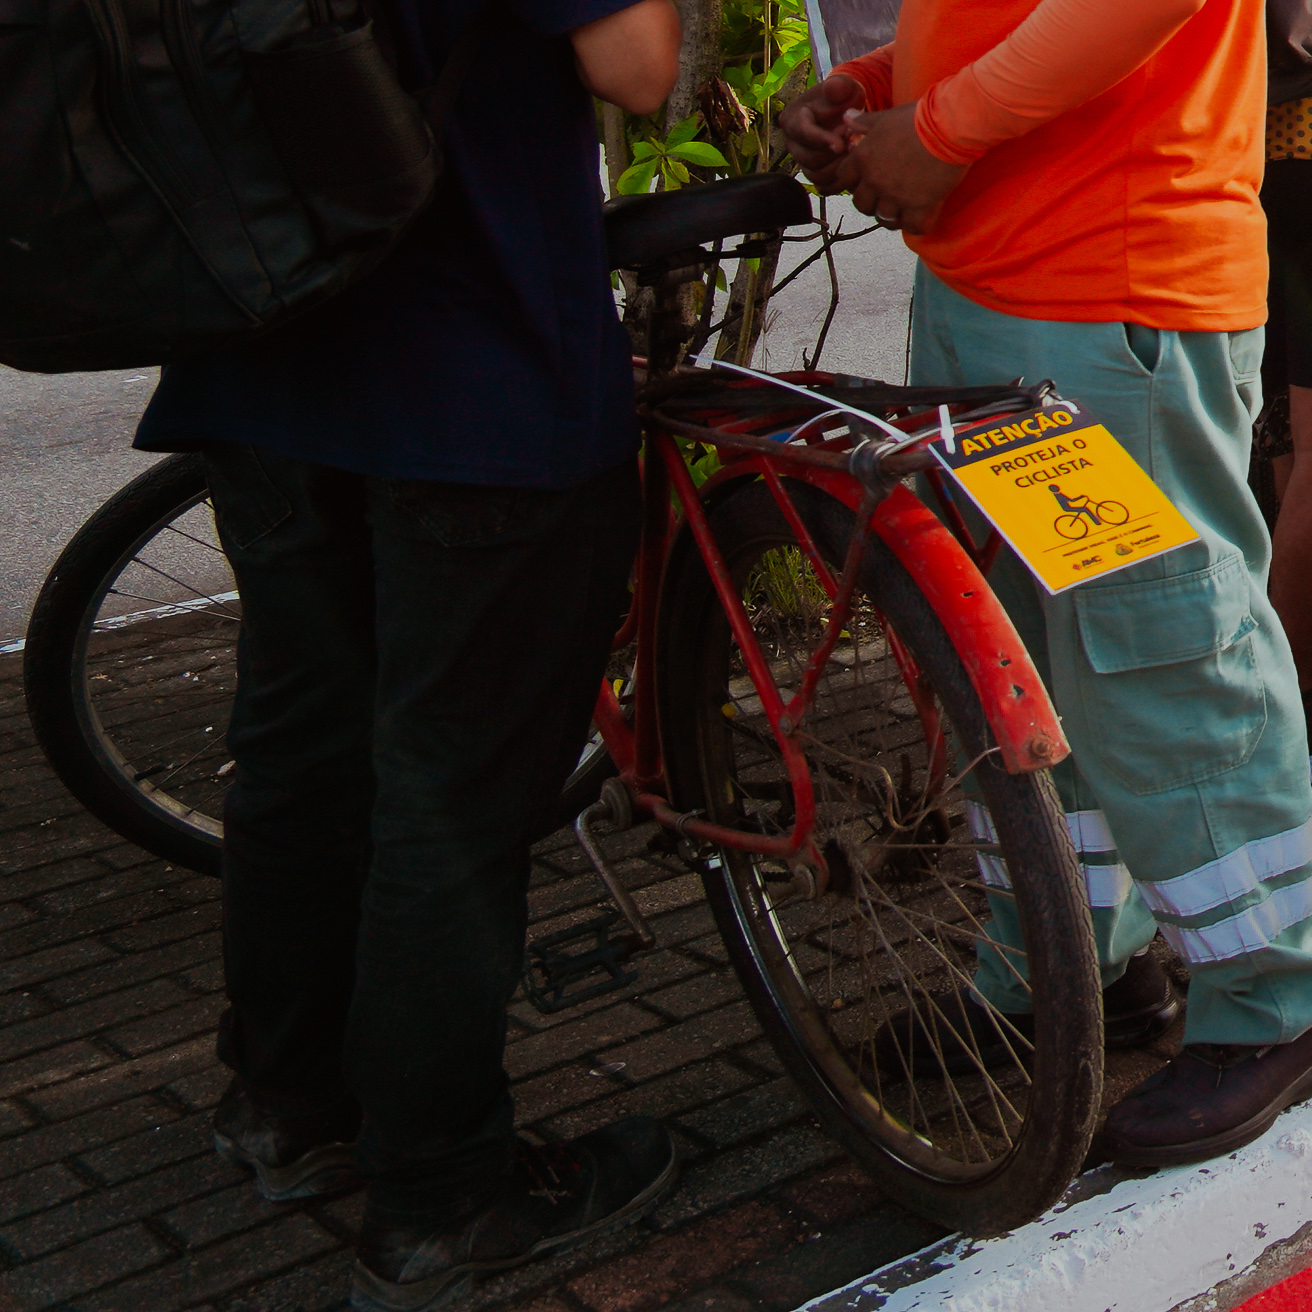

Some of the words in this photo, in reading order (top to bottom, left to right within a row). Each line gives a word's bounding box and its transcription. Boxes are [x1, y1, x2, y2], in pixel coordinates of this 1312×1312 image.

[962, 410, 1074, 457] ATENÇÃO
[990, 443, 1071, 477] PROTEJA
[1072, 438, 1087, 450] O
[1014, 457, 1094, 489] CICLISTA
